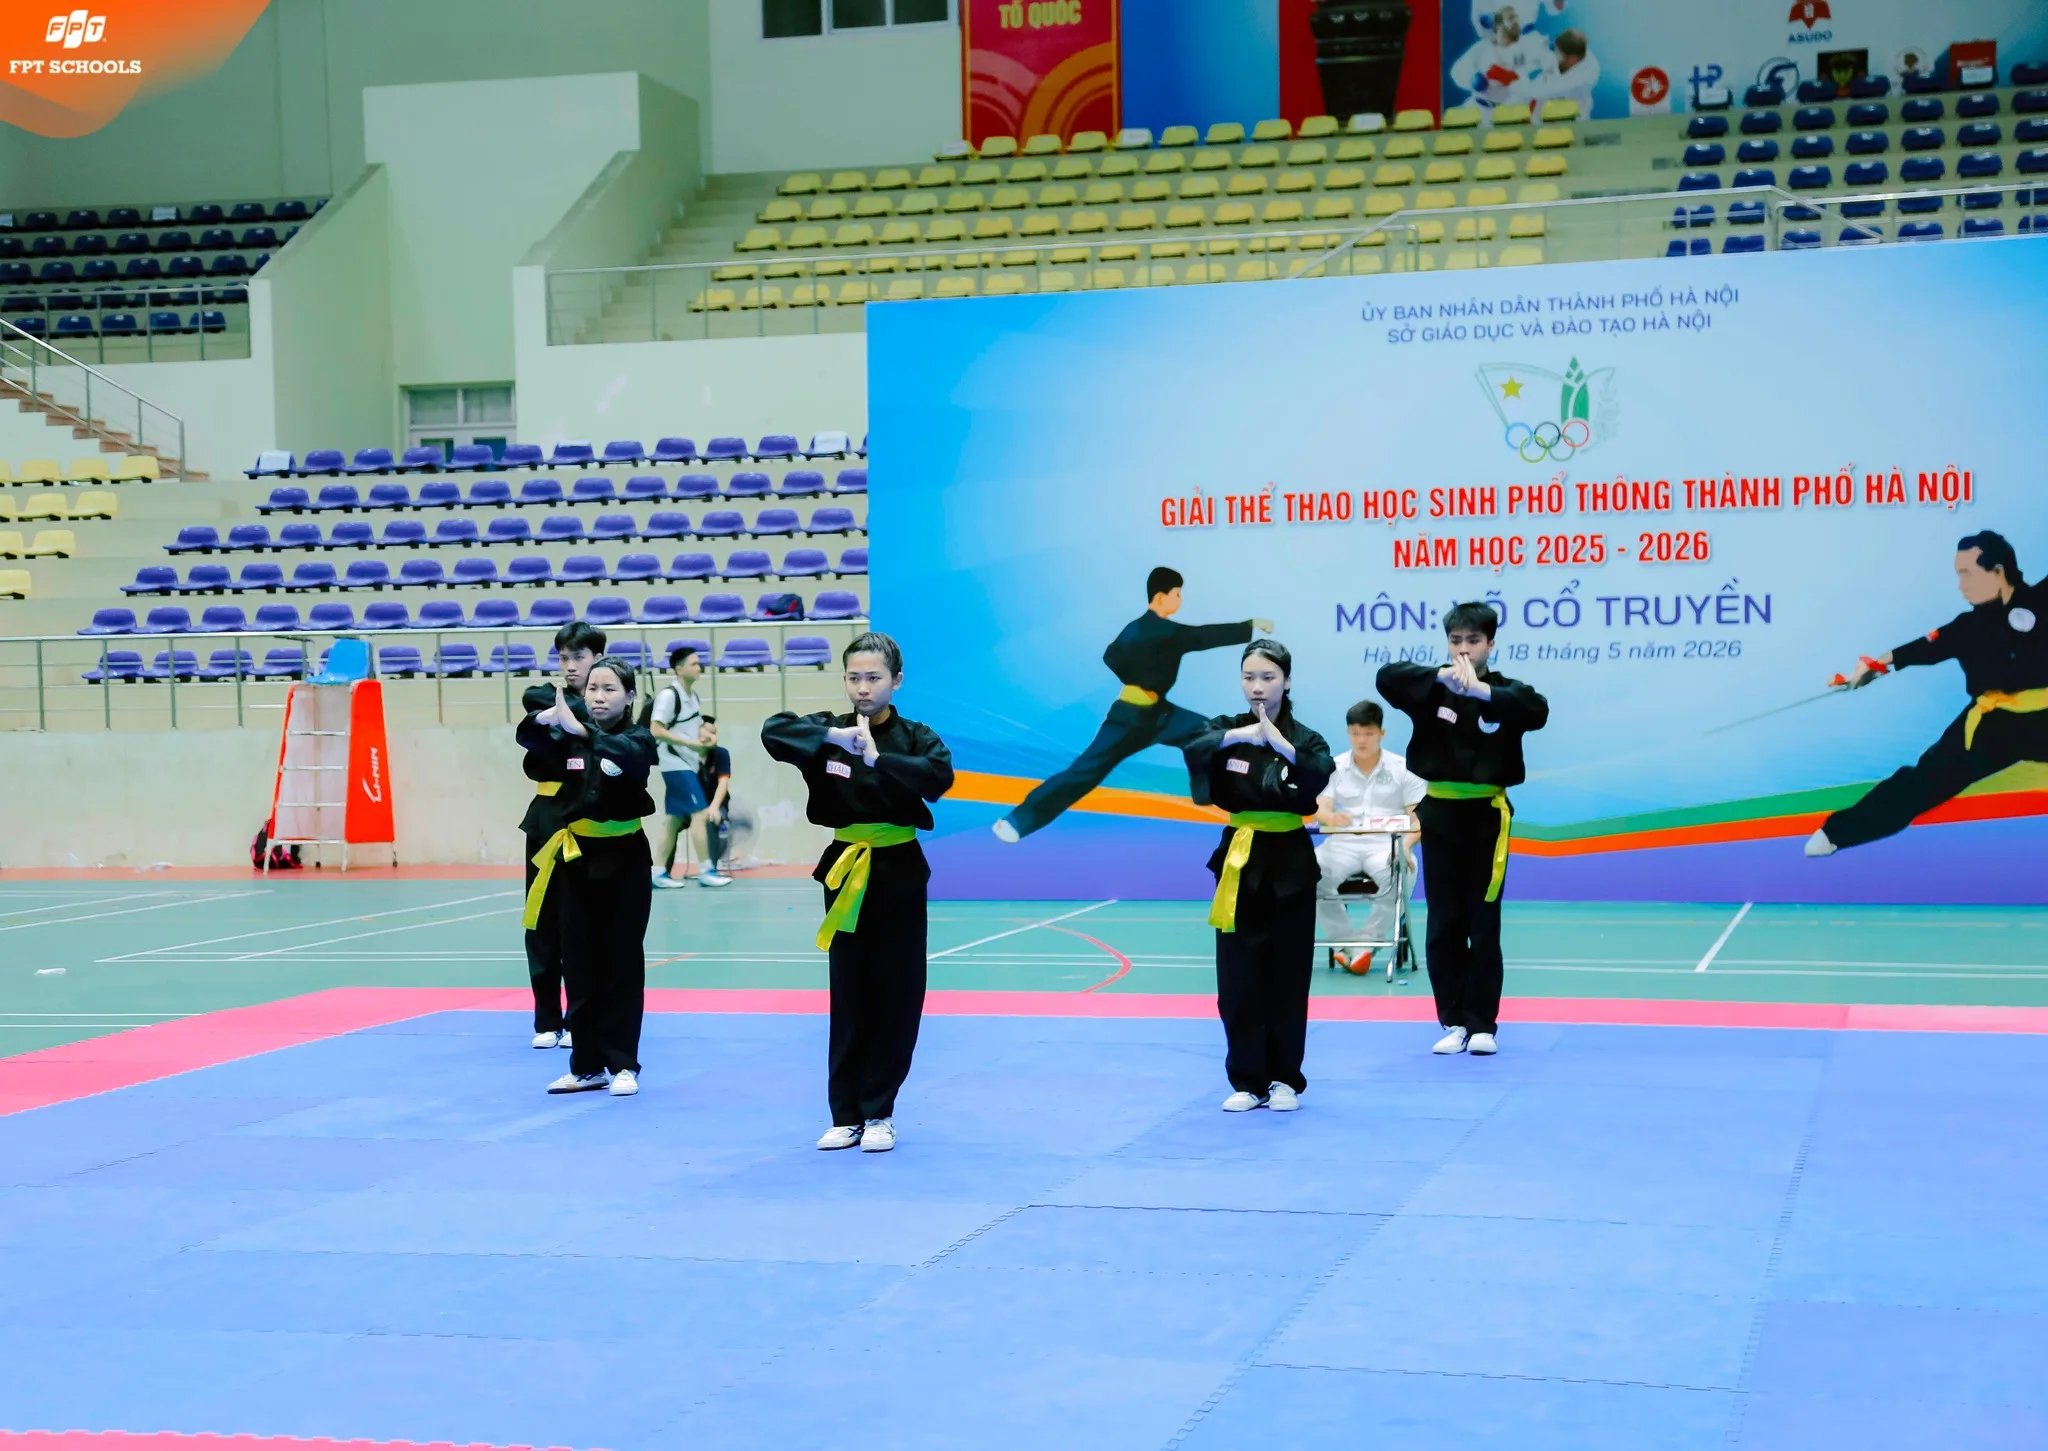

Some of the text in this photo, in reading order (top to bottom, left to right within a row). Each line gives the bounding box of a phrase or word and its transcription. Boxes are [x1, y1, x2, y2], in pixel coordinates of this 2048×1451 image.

[1788, 30, 1833, 43] ASUDO
[1362, 283, 1739, 321] ỦY BAN NHÂN DÂN THÀNH PHỐ HÀ NỘI
[1388, 308, 1711, 343] SỞ GIÁO DỤC VÀ ĐÀO TẠO HÀ NỘI
[1161, 462, 1971, 527] GIẢI THỂ THAO HỌC SINH PHỔ THÔNG THÀNH PHỐ HÀ NỘI
[1393, 532, 1457, 568] NĂM
[1469, 535, 1523, 573] HỌC
[1536, 533, 1604, 564] 2025
[1638, 531, 1709, 562] 2026
[1336, 592, 1437, 632] MÔN:
[1523, 579, 1581, 628] CỔ
[1595, 577, 1772, 627] TRUYỀN
[1364, 645, 1391, 664] Hà
[1508, 643, 1530, 661] 18
[1538, 640, 1600, 664] tháng
[1607, 642, 1621, 660] 5
[1628, 641, 1676, 660] năm
[1683, 640, 1743, 660] 2026
